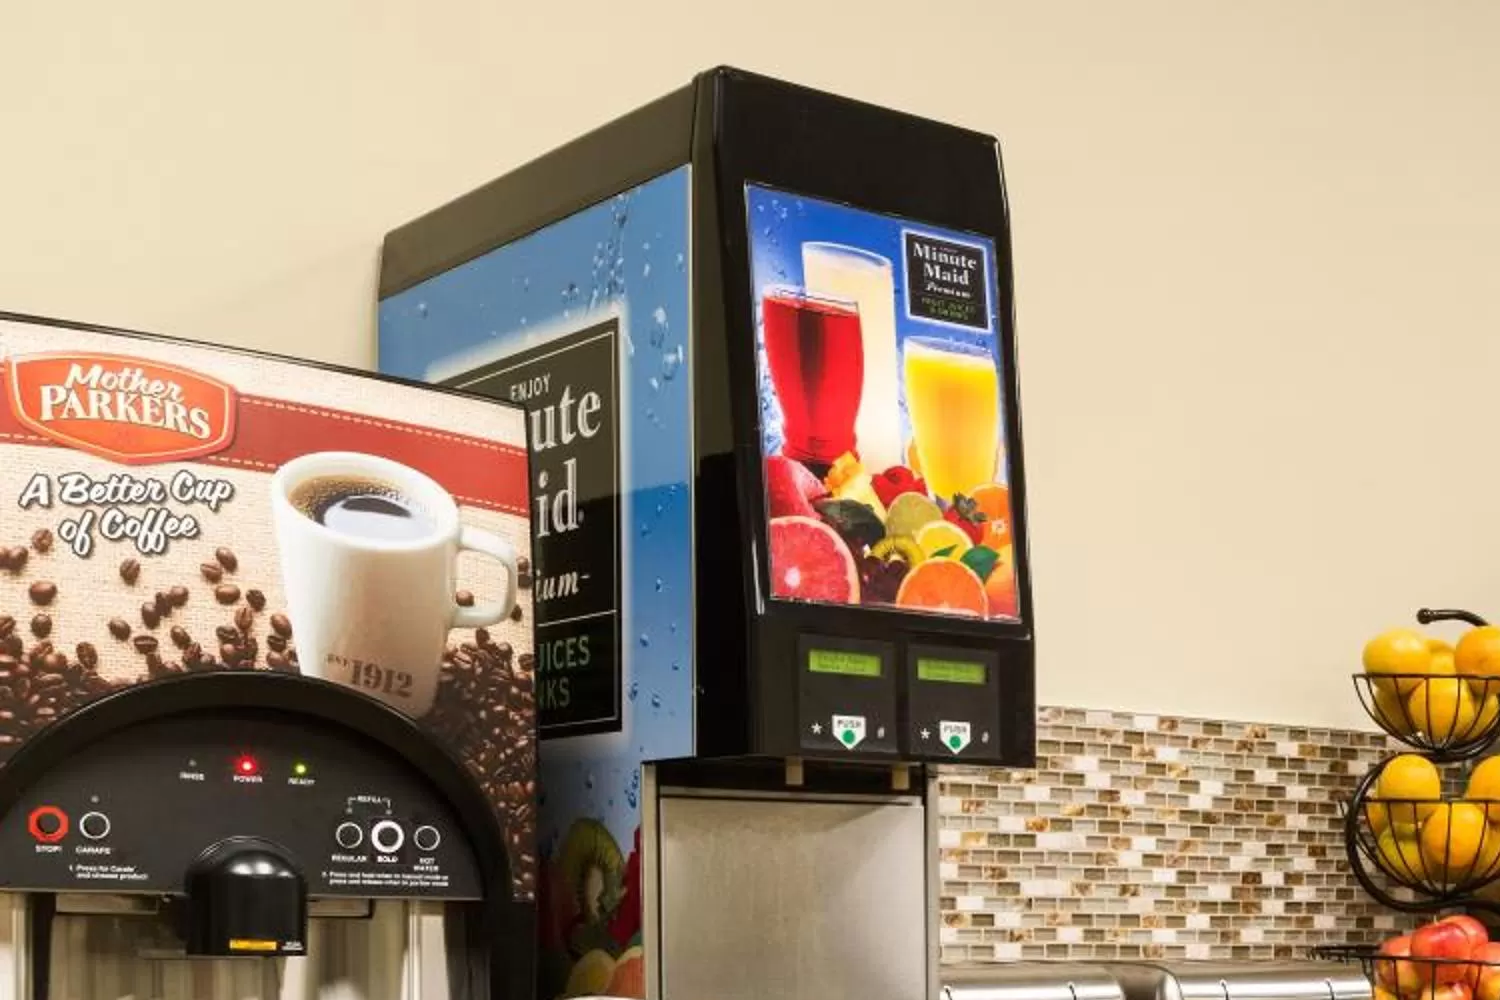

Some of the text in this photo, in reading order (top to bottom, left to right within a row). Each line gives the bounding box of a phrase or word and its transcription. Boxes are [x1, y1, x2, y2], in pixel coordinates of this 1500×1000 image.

[913, 242, 977, 270] Minute
[923, 262, 969, 285] Maid
[64, 363, 184, 402] Mother
[511, 374, 551, 401] ENJOY
[40, 385, 211, 439] PARKERS
[530, 384, 602, 452] ute
[18, 469, 235, 512] A Better Cup
[58, 507, 200, 557] of Coffee
[351, 659, 413, 699] 1912
[837, 718, 862, 729] PUSH
[943, 724, 968, 734] PUSH
[233, 775, 263, 783] POWER
[377, 855, 398, 863] BOLD
